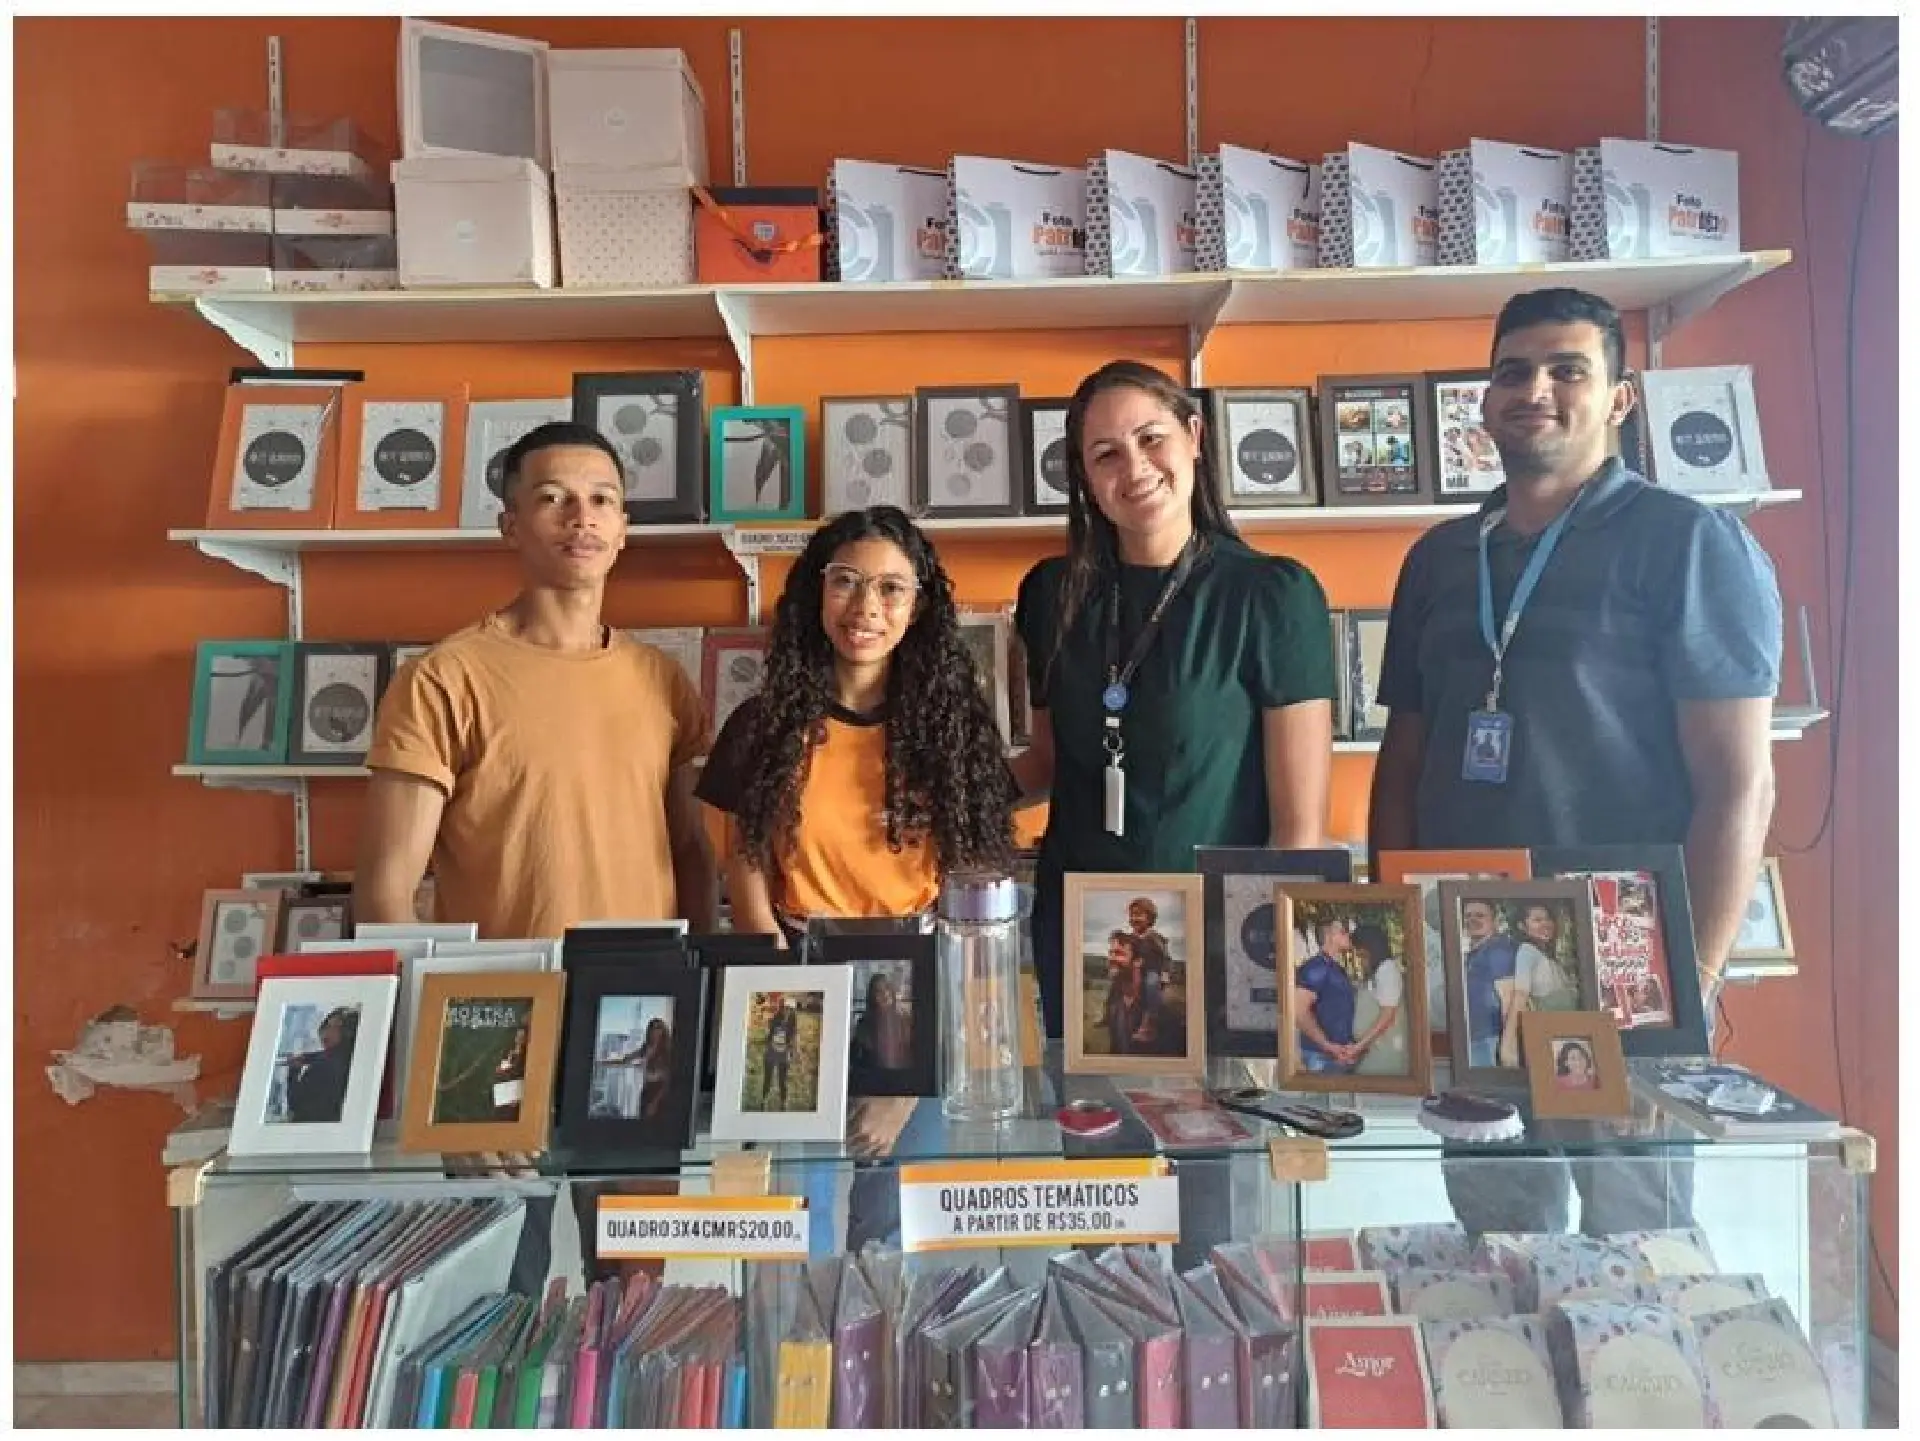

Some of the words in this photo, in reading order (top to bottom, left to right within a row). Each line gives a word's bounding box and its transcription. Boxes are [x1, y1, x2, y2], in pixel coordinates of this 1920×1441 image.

[940, 1184, 1028, 1212] QUADROS
[1033, 1181, 1139, 1209] TEMÁTICOS
[953, 1214, 964, 1233] A
[967, 1212, 1019, 1233] PARTIR
[1023, 1212, 1042, 1231] DE
[1333, 1352, 1397, 1378] Amor
